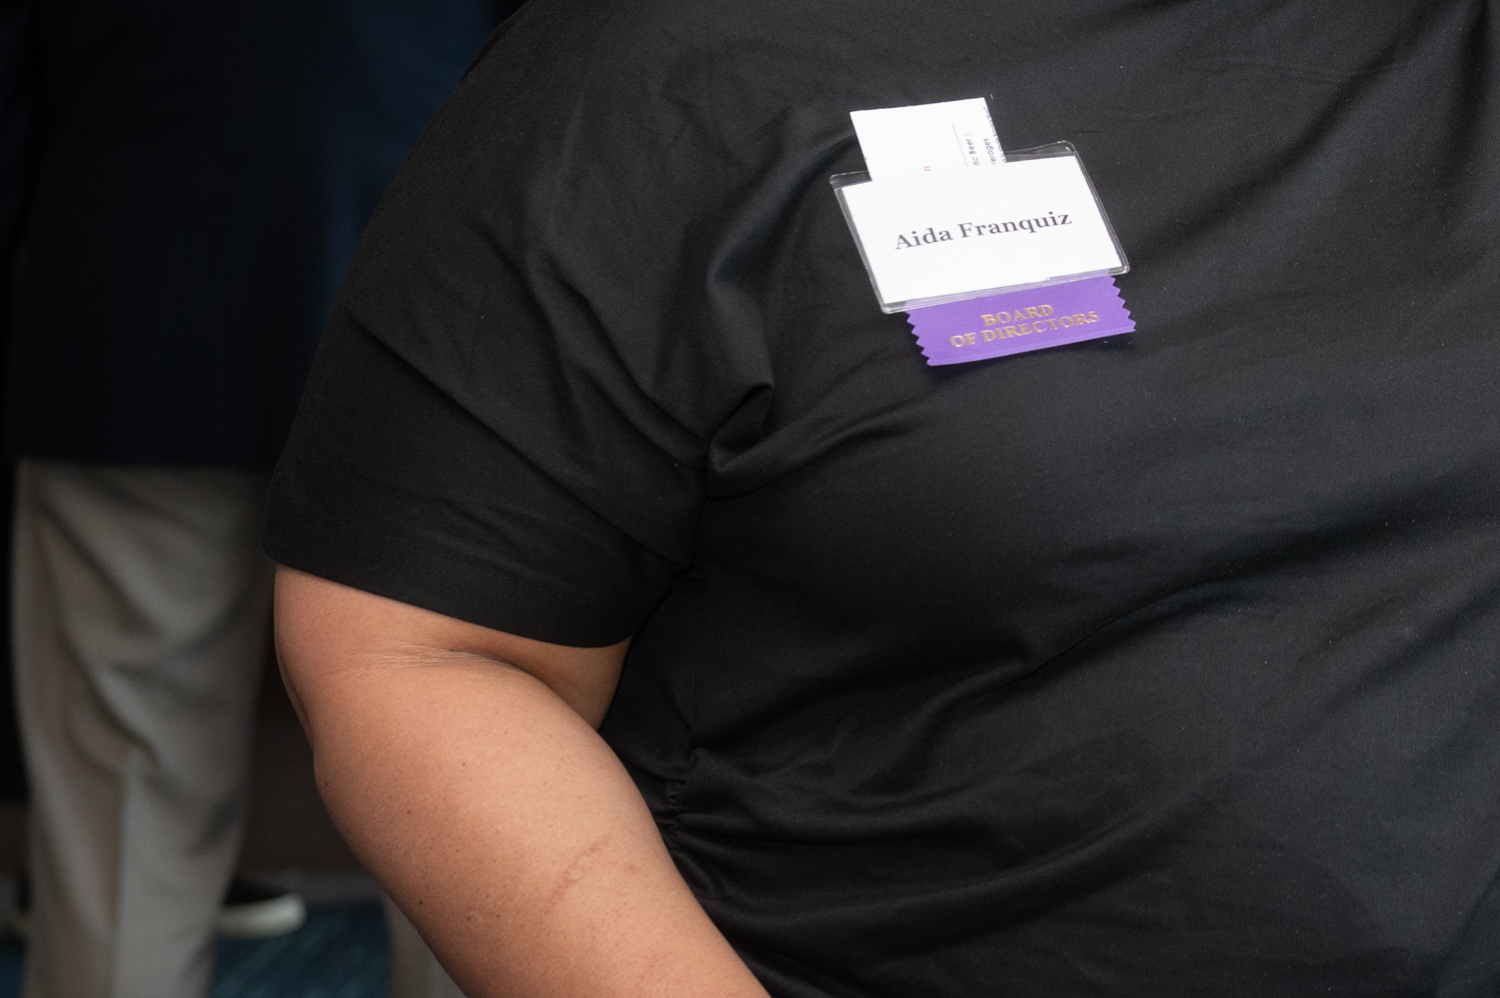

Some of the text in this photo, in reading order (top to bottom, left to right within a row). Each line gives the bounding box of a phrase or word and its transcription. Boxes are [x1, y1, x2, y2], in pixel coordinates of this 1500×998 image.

[965, 138, 976, 155] Beer
[894, 210, 1073, 251] Aida Franquiz
[949, 310, 1100, 348] OF DIRECTORS
[980, 303, 1054, 328] BOARD
